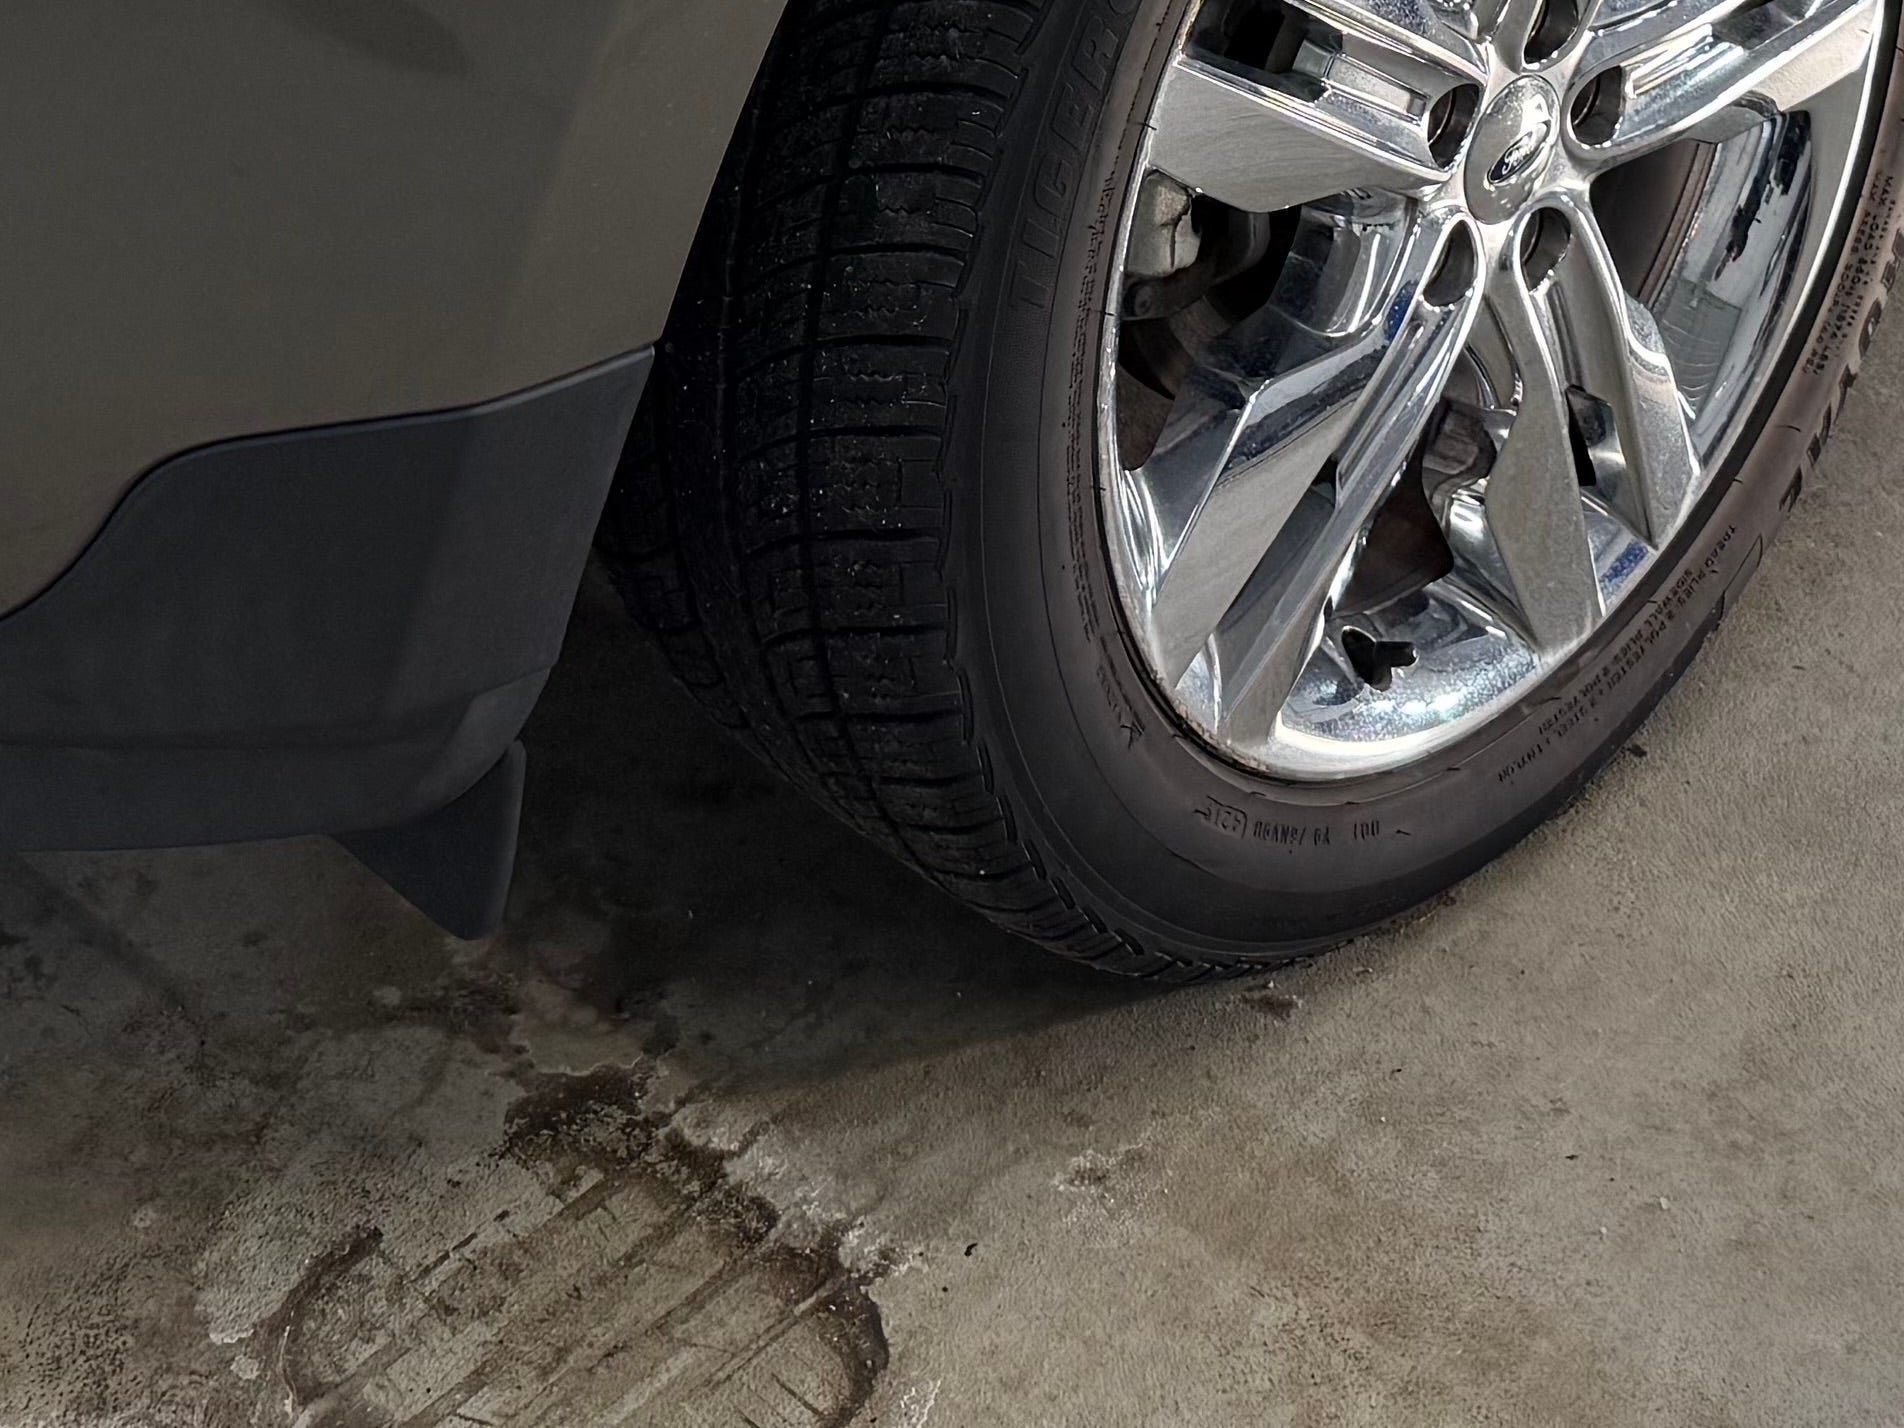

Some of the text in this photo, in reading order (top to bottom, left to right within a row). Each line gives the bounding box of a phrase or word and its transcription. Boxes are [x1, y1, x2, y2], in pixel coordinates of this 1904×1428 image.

[1008, 14, 1119, 312] TIGER
[1704, 524, 1736, 569] TREAD
[1642, 569, 1694, 628] SIDEWALL
